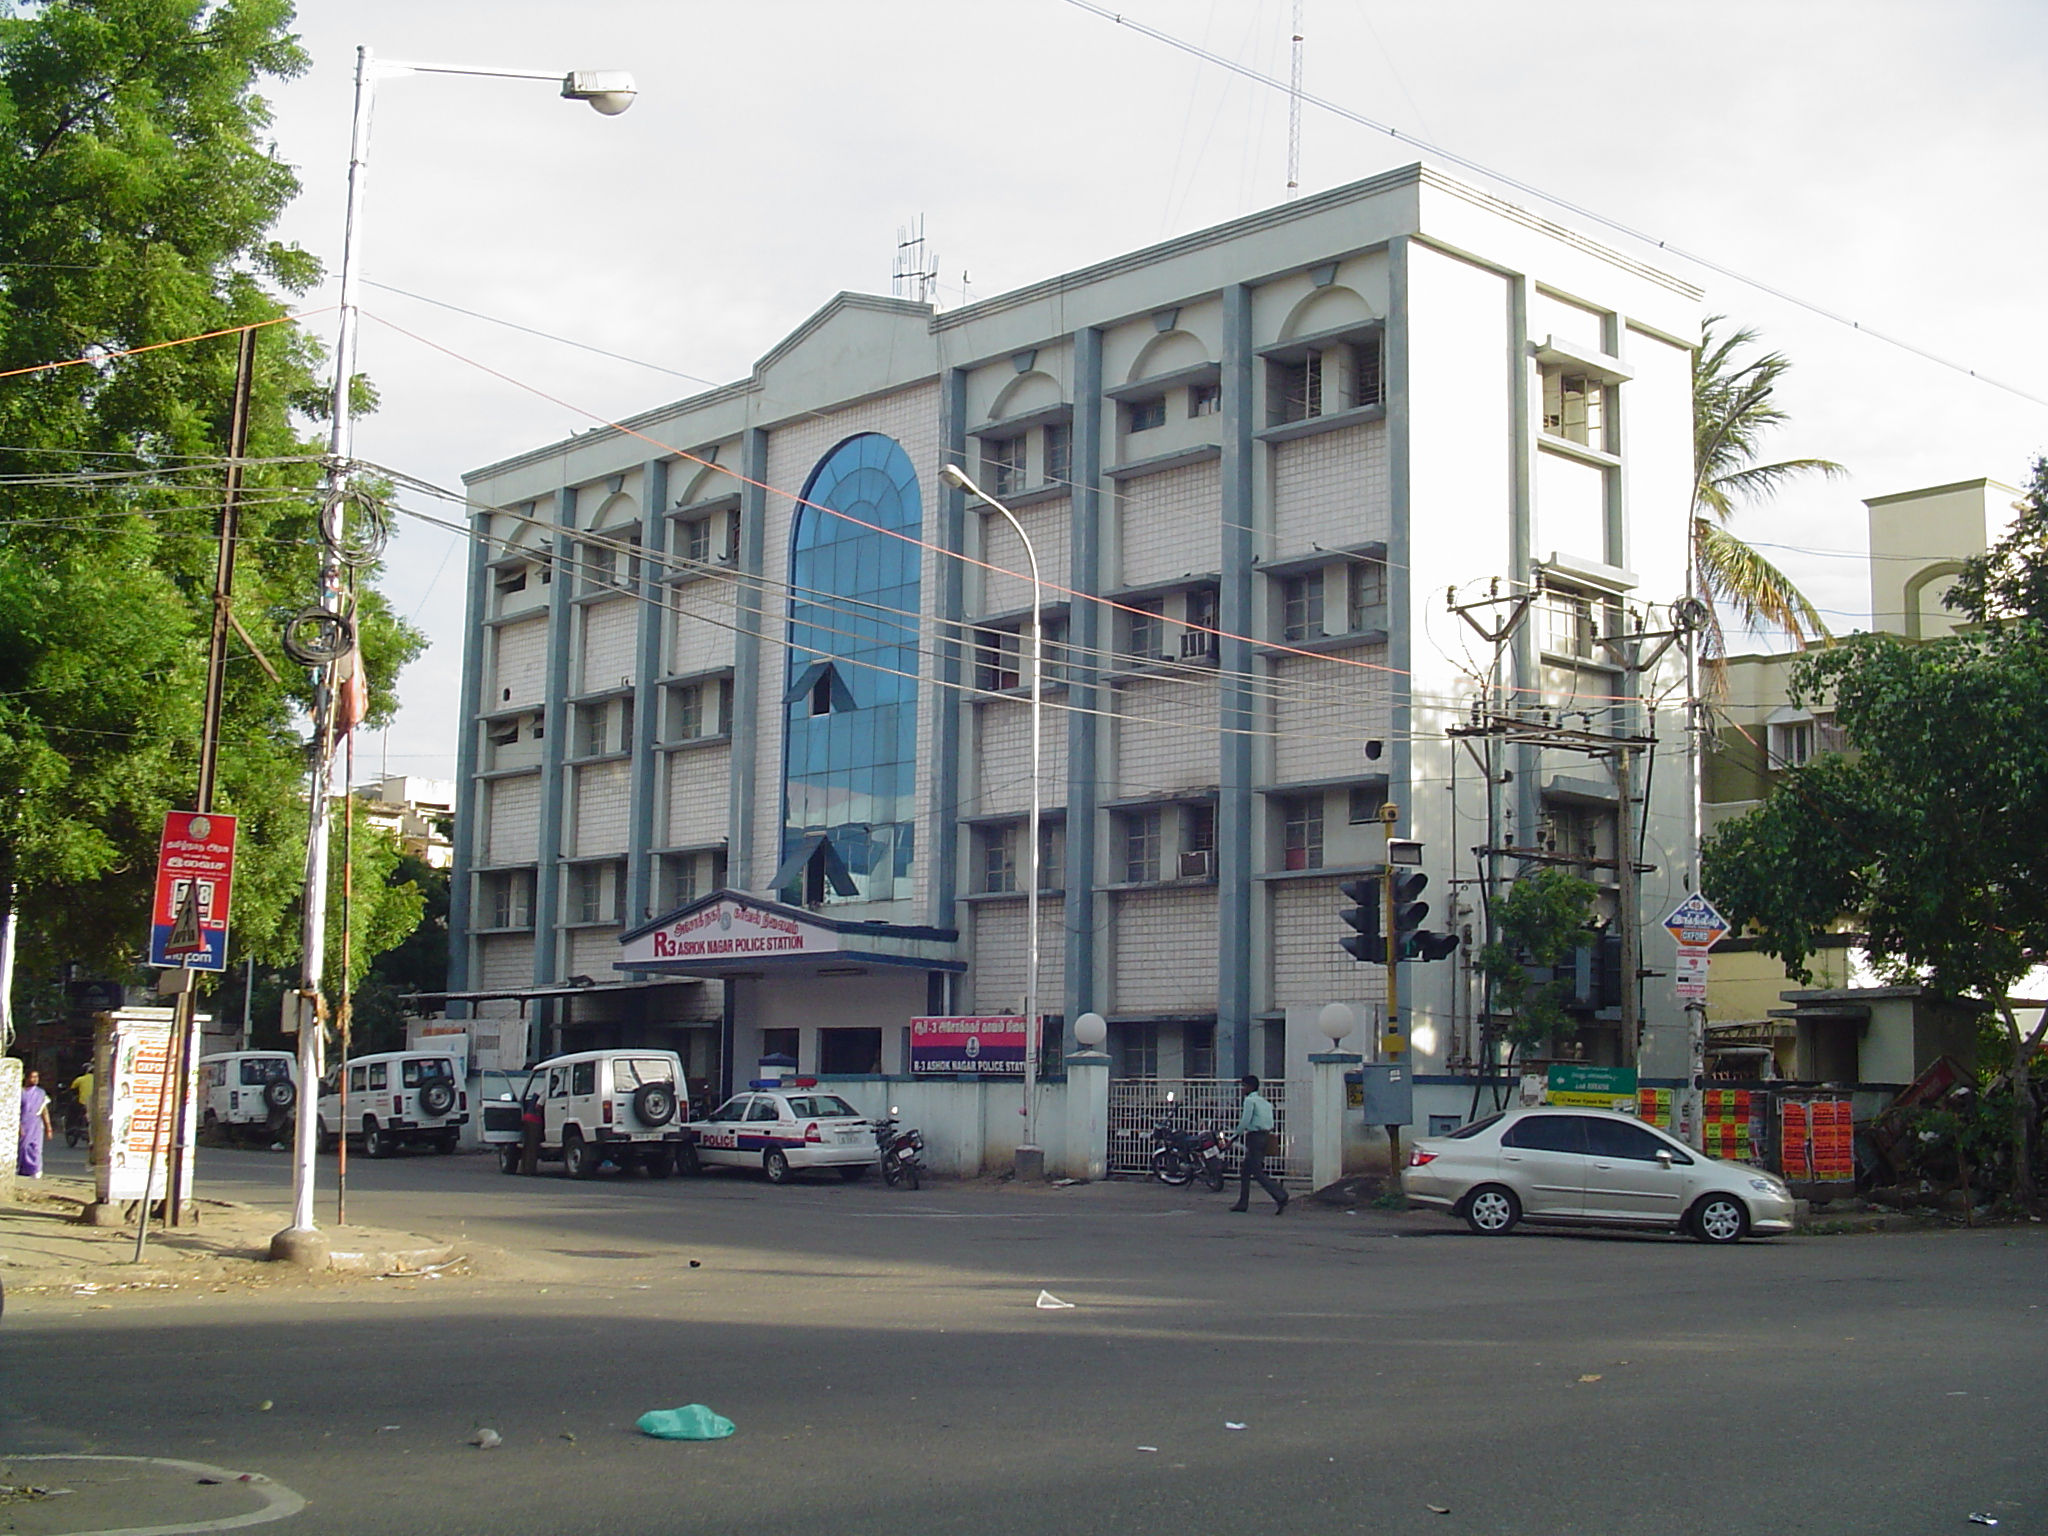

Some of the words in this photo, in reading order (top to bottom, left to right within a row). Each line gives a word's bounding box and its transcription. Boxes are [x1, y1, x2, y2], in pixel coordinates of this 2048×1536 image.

[178, 885, 210, 905] 18
[678, 942, 706, 956] ASHOK
[707, 940, 733, 954] NAGAR
[736, 938, 765, 952] POLICE
[767, 936, 803, 950] STATION
[914, 1061, 926, 1071] R-3
[927, 1061, 951, 1072] ASHOK
[951, 1061, 977, 1072] NAGAR
[979, 1061, 1004, 1072] POLICE
[1005, 1061, 1038, 1072] STATI
[703, 1135, 735, 1147] POLICE
